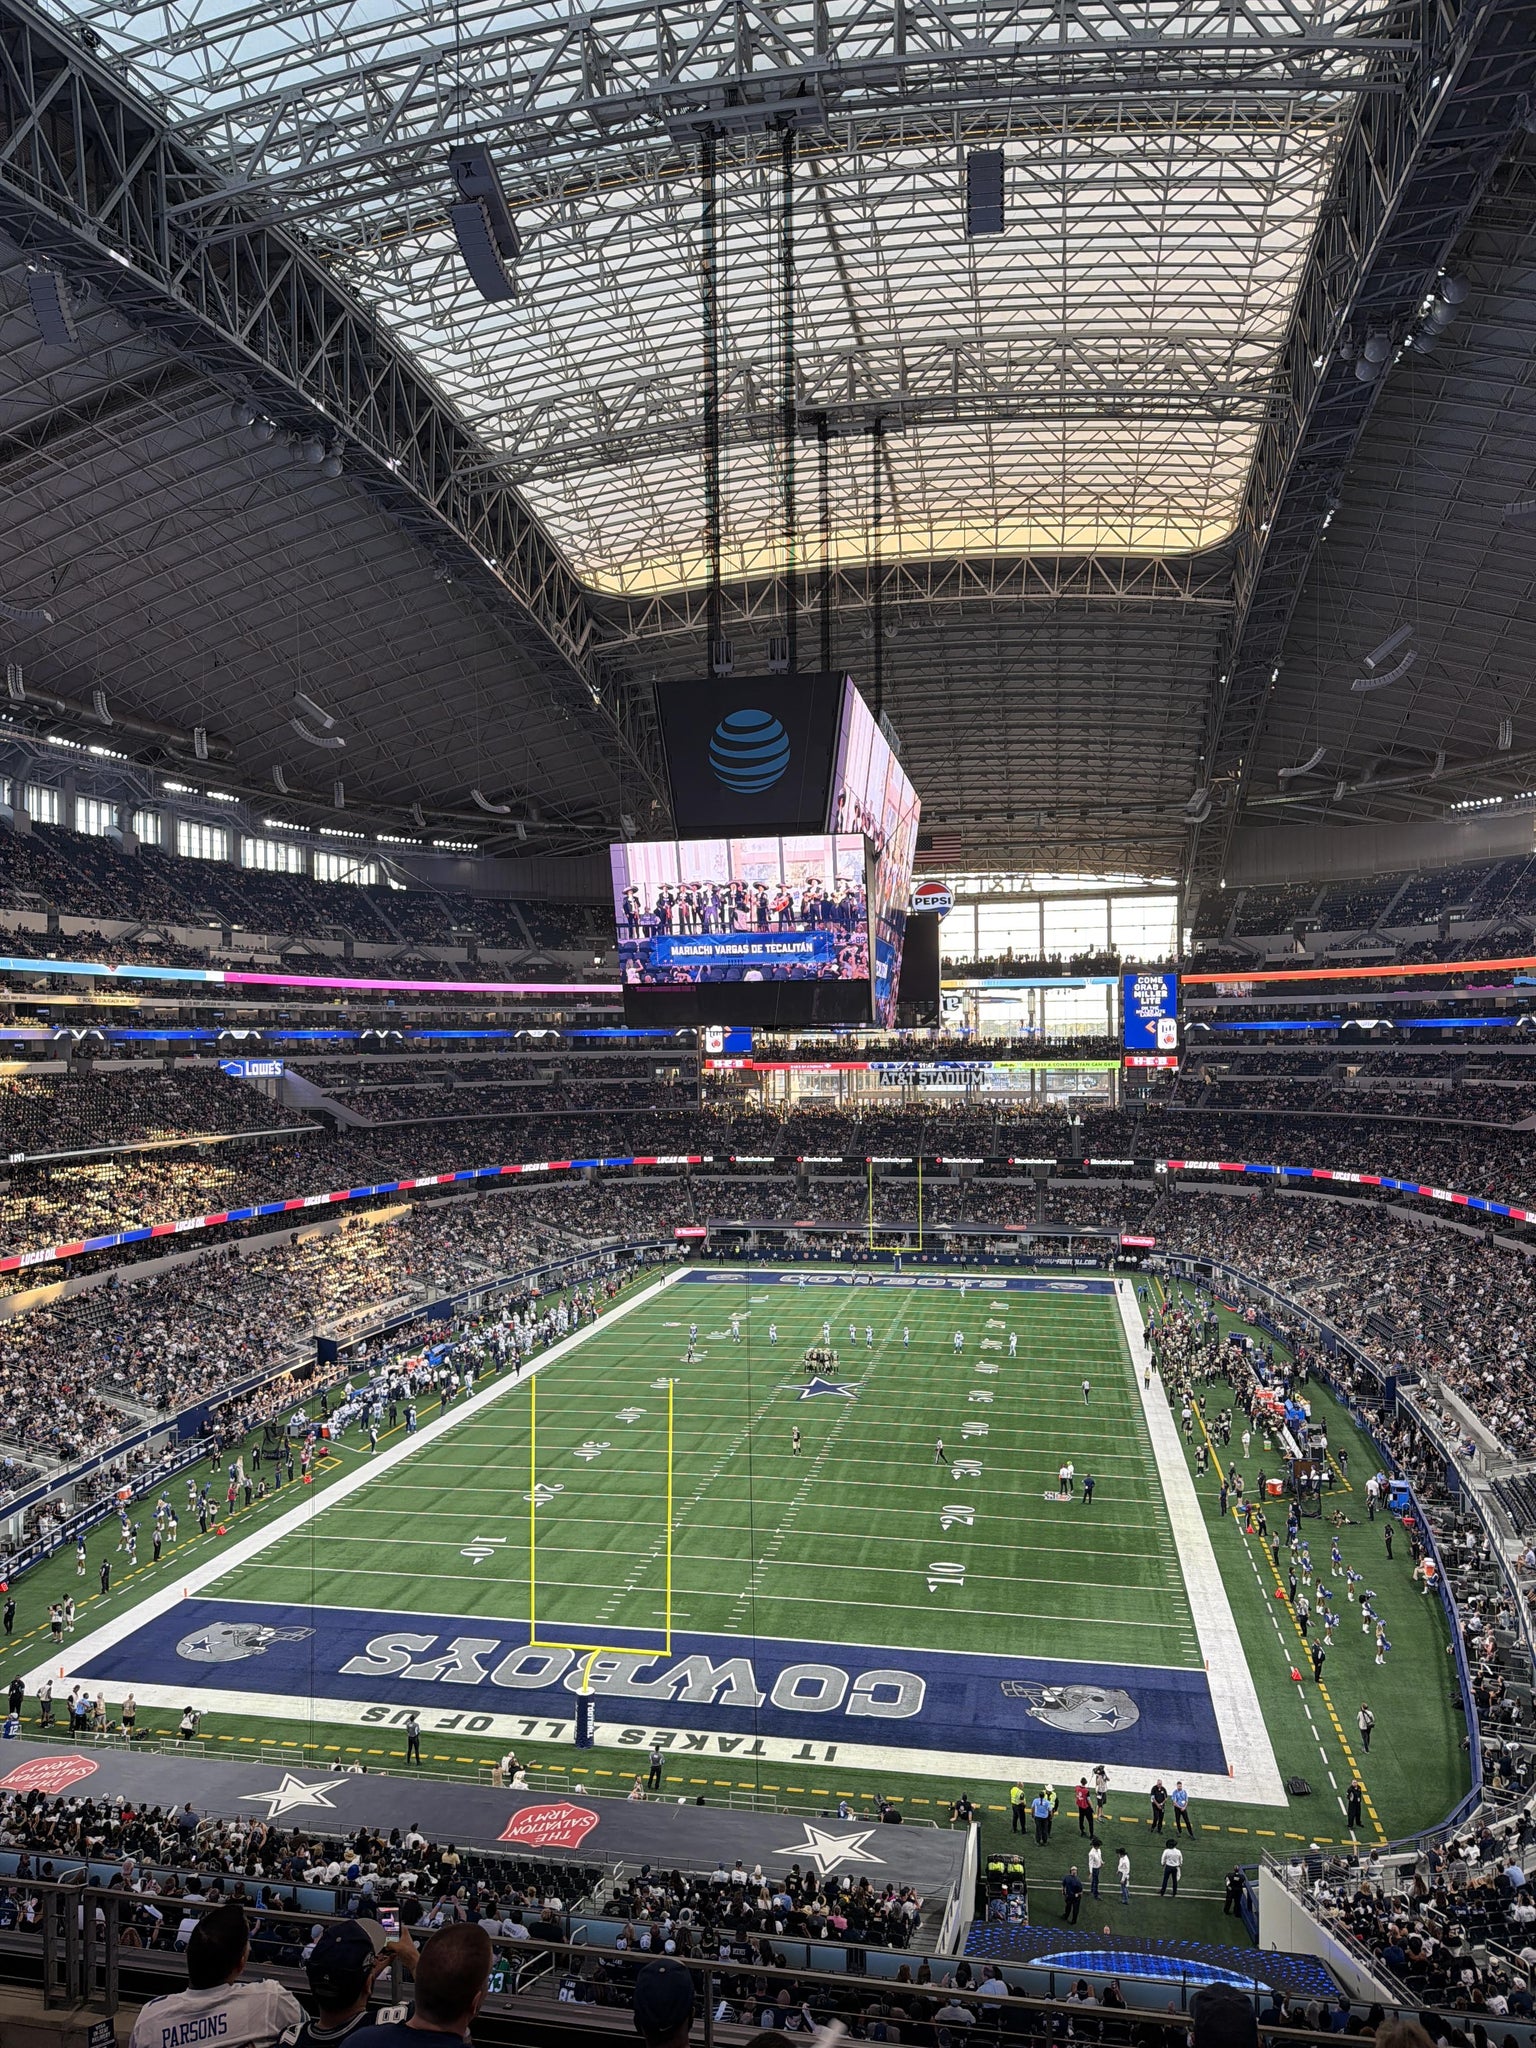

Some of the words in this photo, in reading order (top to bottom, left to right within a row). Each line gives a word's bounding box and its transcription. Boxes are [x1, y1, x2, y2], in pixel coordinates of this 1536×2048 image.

[914, 896, 951, 906] PEPSI
[671, 944, 712, 956] MARIACHI
[715, 944, 750, 954] VARGAS
[751, 944, 764, 954] DE
[766, 942, 813, 953] TECALITÁN
[246, 1060, 282, 1076] LOWE'S
[880, 1072, 915, 1085] AT&T
[918, 1071, 984, 1085] STADIUM
[1155, 1164, 1167, 1172] 25
[1184, 1161, 1207, 1169] LUCAS
[779, 1274, 1007, 1288] COWBOYS
[961, 1422, 989, 1436] 40
[574, 1441, 611, 1456] 30
[951, 1460, 983, 1476] 30
[523, 1483, 564, 1502] 20
[940, 1505, 975, 1526] 20
[460, 1536, 507, 1558] 10
[926, 1562, 966, 1586] 10
[338, 1632, 926, 1718] COWBOYS
[360, 1706, 421, 1726] US
[434, 1714, 494, 1731] OF
[587, 1702, 595, 1738] FOOTBALL
[9, 1726, 18, 1734] 12
[617, 1728, 766, 1756] TAKES
[792, 1743, 838, 1762] IT
[6, 1766, 94, 1784] SALVATION
[22, 1760, 82, 1774] ARMY
[23, 1778, 62, 1789] THE
[520, 1808, 575, 1825] ARMY
[508, 1816, 594, 1837] SALVATION
[534, 1830, 571, 1842] THE
[162, 2012, 228, 2048] PARSONS
